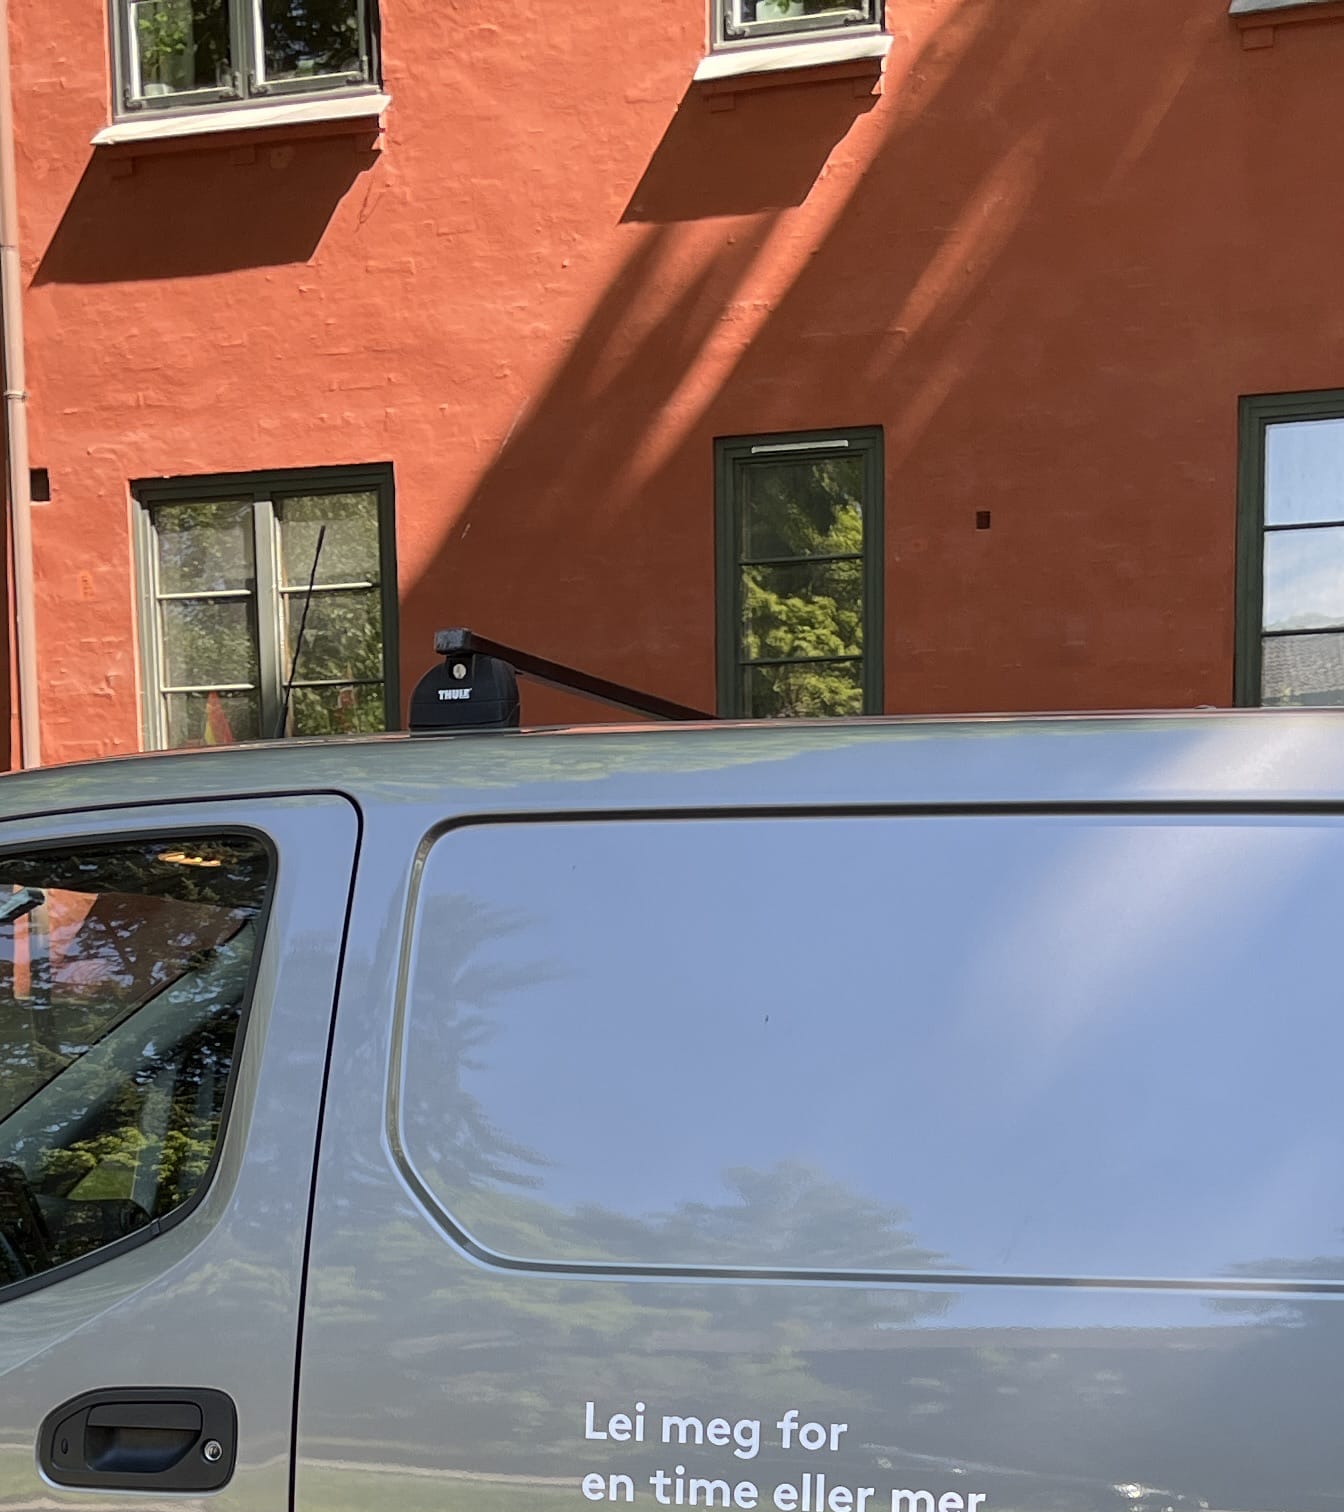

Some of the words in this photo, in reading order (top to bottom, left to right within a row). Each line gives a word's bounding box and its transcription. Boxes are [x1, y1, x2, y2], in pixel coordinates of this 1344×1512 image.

[438, 688, 471, 700] THULE
[584, 1401, 646, 1443] Lei
[661, 1412, 761, 1460] meg
[776, 1409, 848, 1451] for
[581, 1471, 635, 1503] en
[649, 1465, 759, 1510] time
